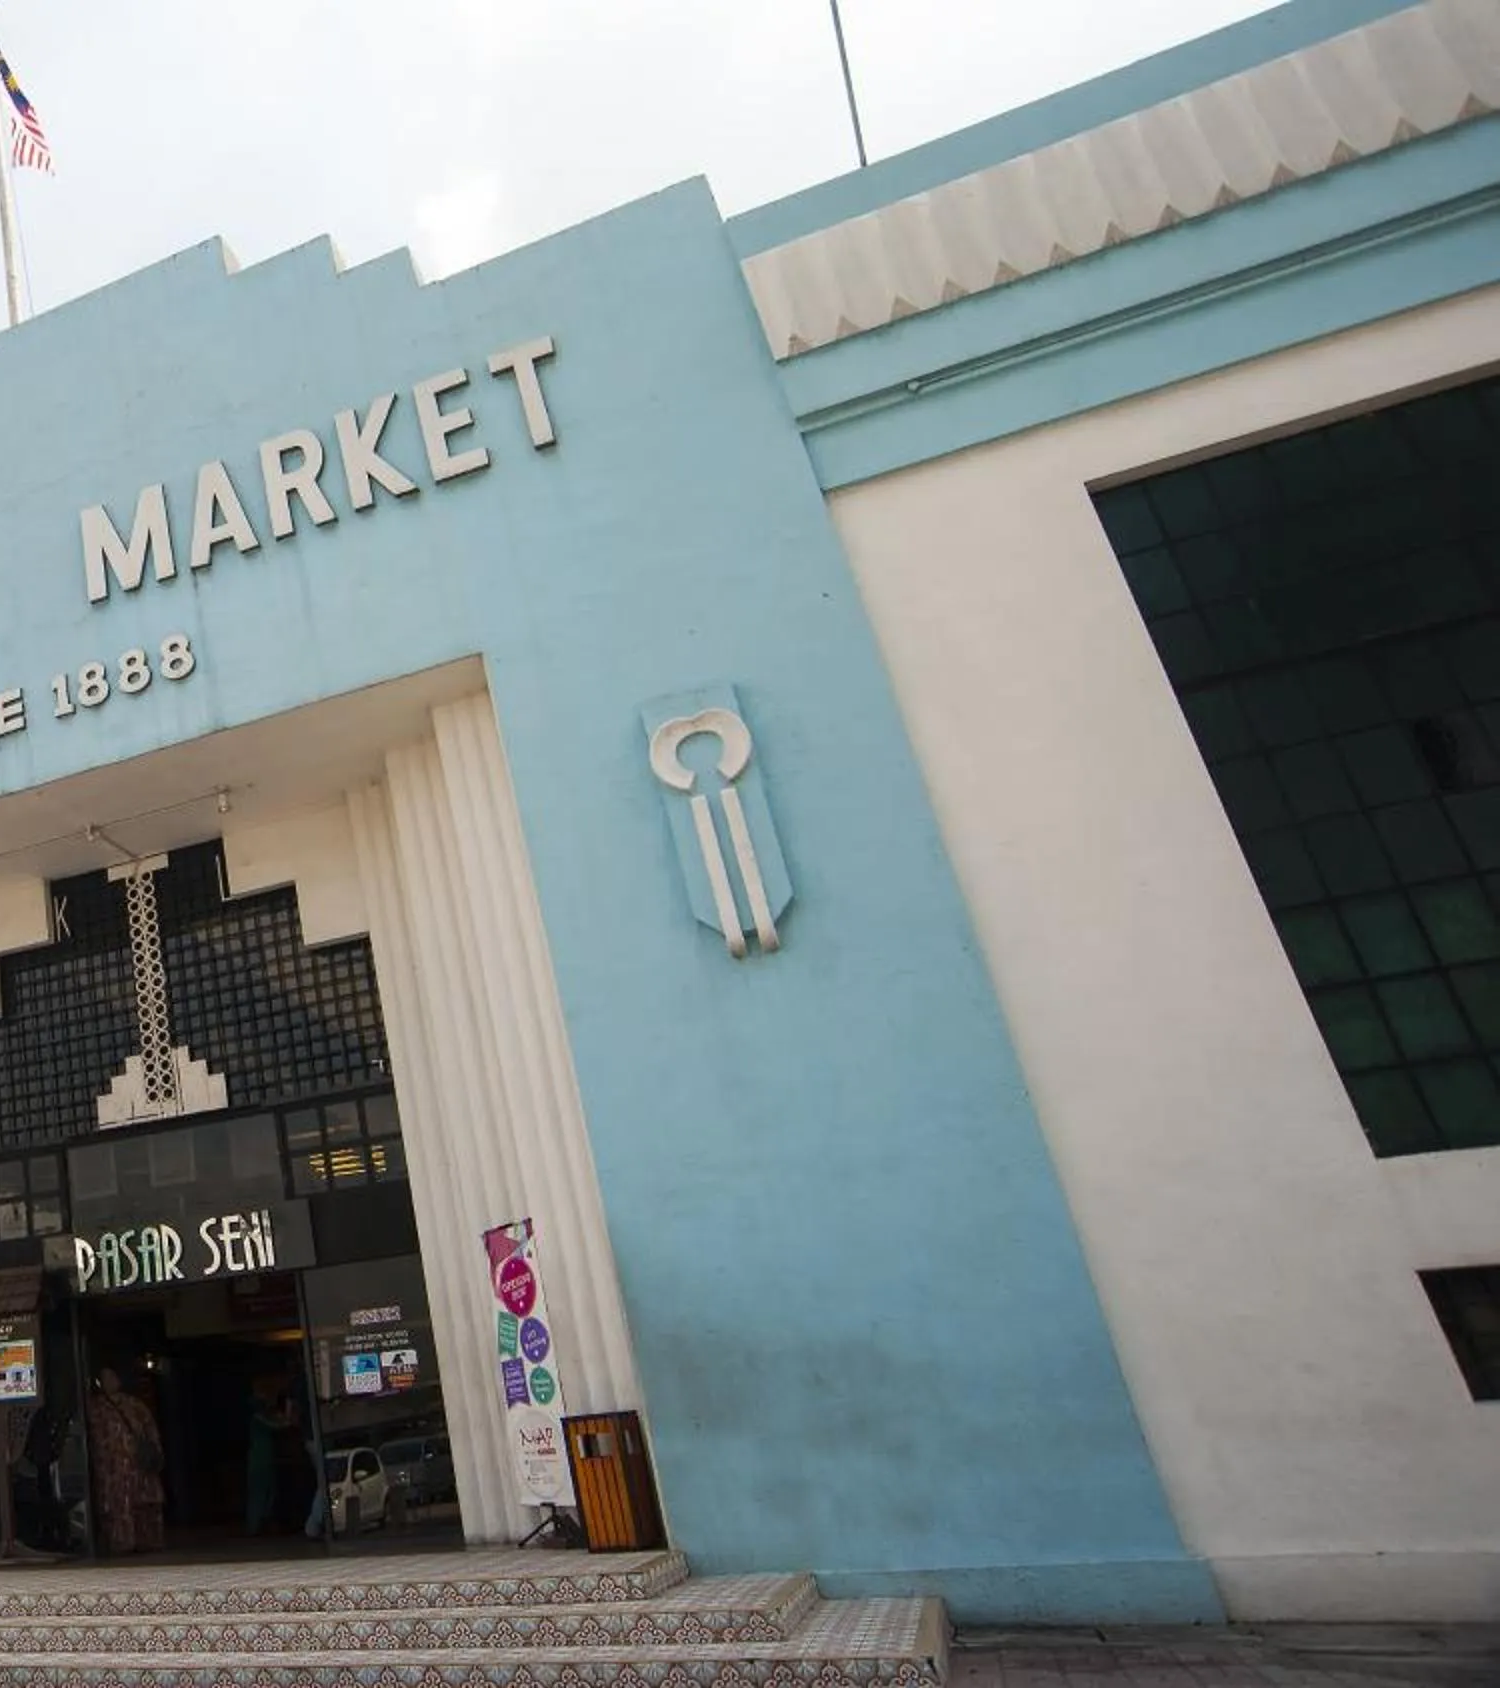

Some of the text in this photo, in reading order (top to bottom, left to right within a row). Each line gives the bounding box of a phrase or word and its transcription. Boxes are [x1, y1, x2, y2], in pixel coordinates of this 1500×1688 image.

[80, 336, 557, 605] MARKET
[51, 632, 197, 719] 1888
[73, 1208, 276, 1293] PASAR SENI
